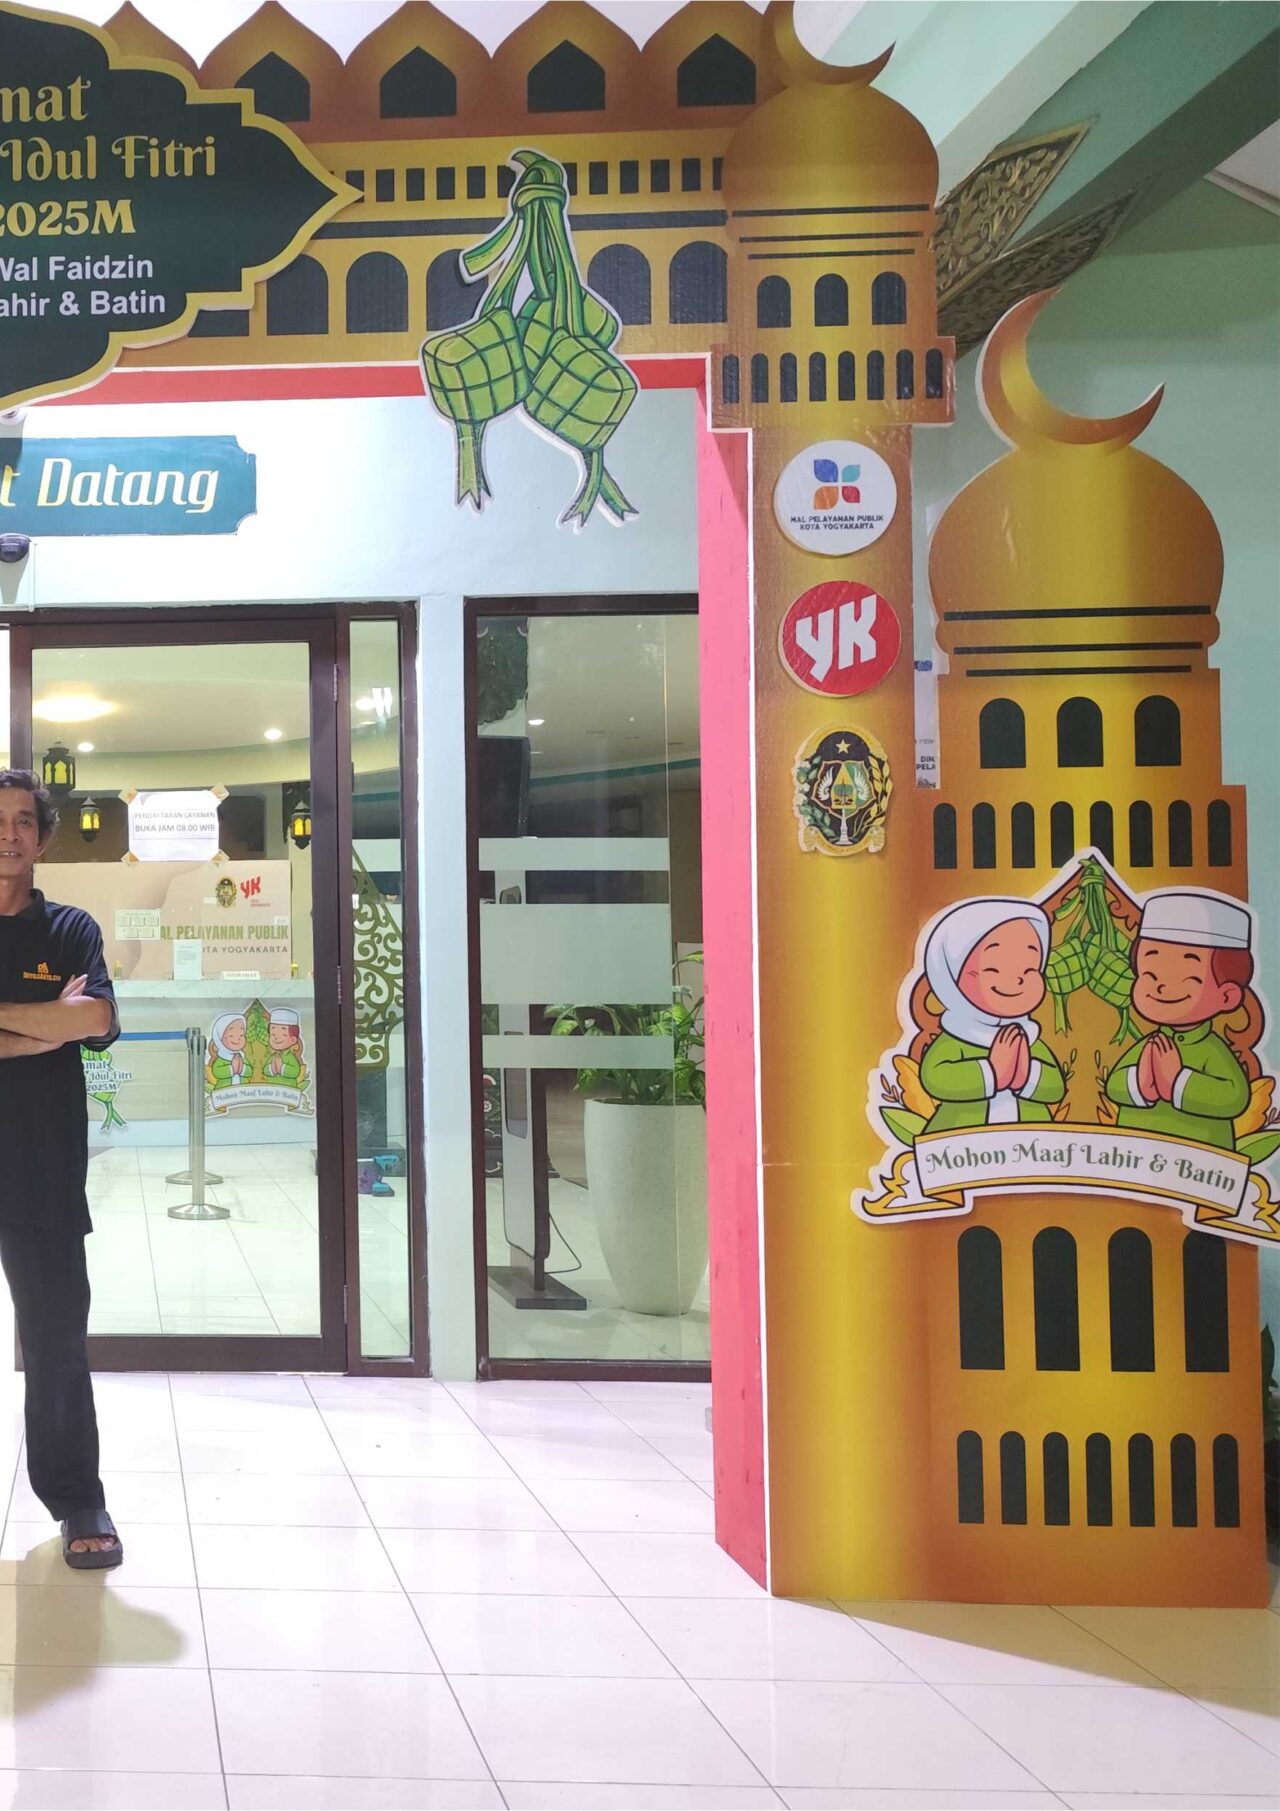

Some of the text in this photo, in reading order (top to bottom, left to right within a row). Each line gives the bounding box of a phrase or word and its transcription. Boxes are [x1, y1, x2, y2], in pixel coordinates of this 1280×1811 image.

[111, 135, 216, 179] Fitri
[49, 254, 153, 281] Faidzin
[58, 290, 80, 316] &
[90, 289, 166, 315] Batin
[37, 457, 218, 514] Datang
[790, 514, 884, 523] MAL PELAYANAN PUBLIK
[823, 522, 874, 530] YOGYAKARTA
[920, 755, 935, 763] DIN
[183, 811, 216, 819] LAYANAN
[158, 824, 175, 832] JAM
[176, 824, 198, 832] 08.00
[199, 824, 216, 832] WIB
[160, 925, 289, 940] AL PELAYANAN PUBLIK
[221, 945, 288, 953] YOGYAKARTA
[84, 1061, 107, 1070] mat
[86, 1083, 117, 1092] 2025M
[215, 1092, 238, 1101] Mohon
[258, 1089, 274, 1097] Lahir
[282, 1091, 299, 1100] Batin
[925, 1138, 1237, 1194] Mohon Maaf Lahir & Batin
